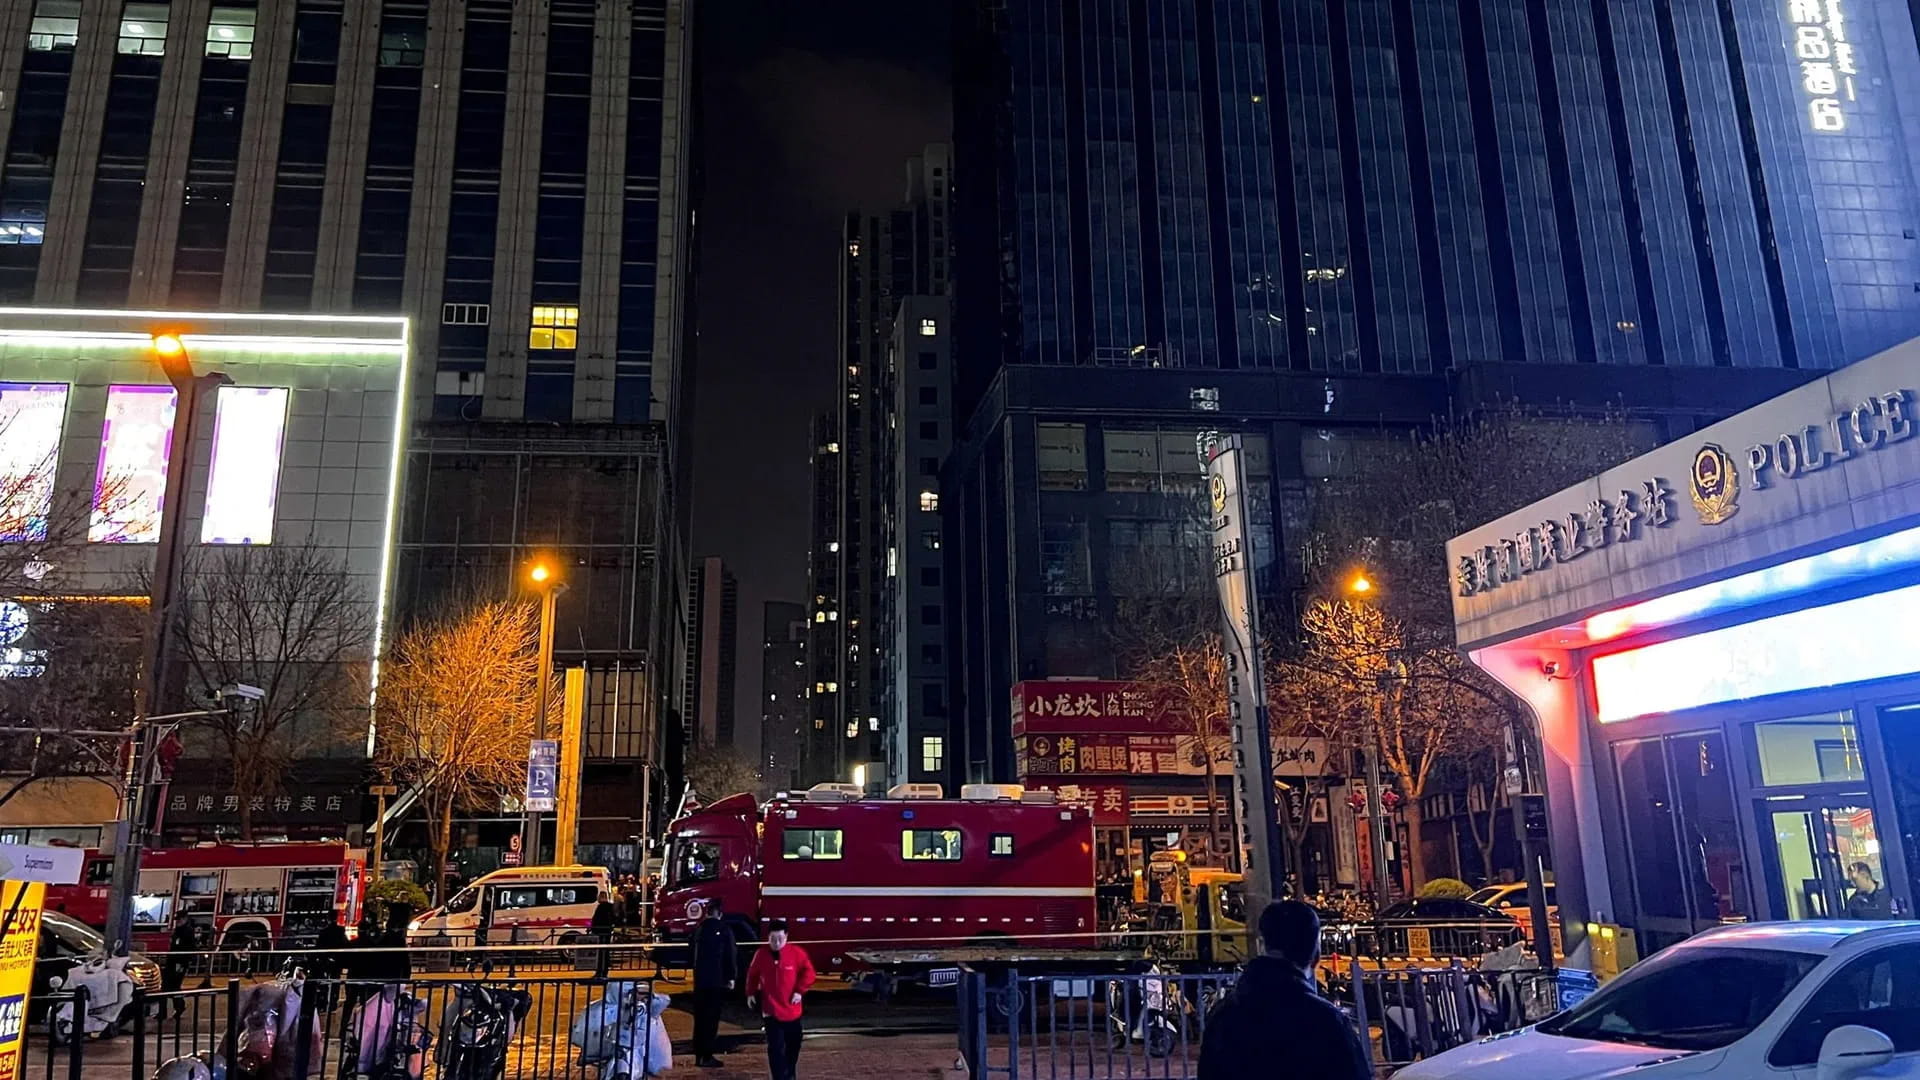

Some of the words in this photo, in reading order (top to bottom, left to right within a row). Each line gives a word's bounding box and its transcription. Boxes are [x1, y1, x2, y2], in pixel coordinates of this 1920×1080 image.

[1745, 390, 1914, 490] POLICE
[1028, 692, 1102, 718] 小龙坎
[1107, 692, 1121, 717] 火锅
[1122, 709, 1145, 717] KAN
[1057, 736, 1076, 773] 烤肉
[1081, 745, 1128, 770] 肉蟹煲
[534, 769, 547, 787] P
[170, 794, 343, 812] 品牌男装特卖店
